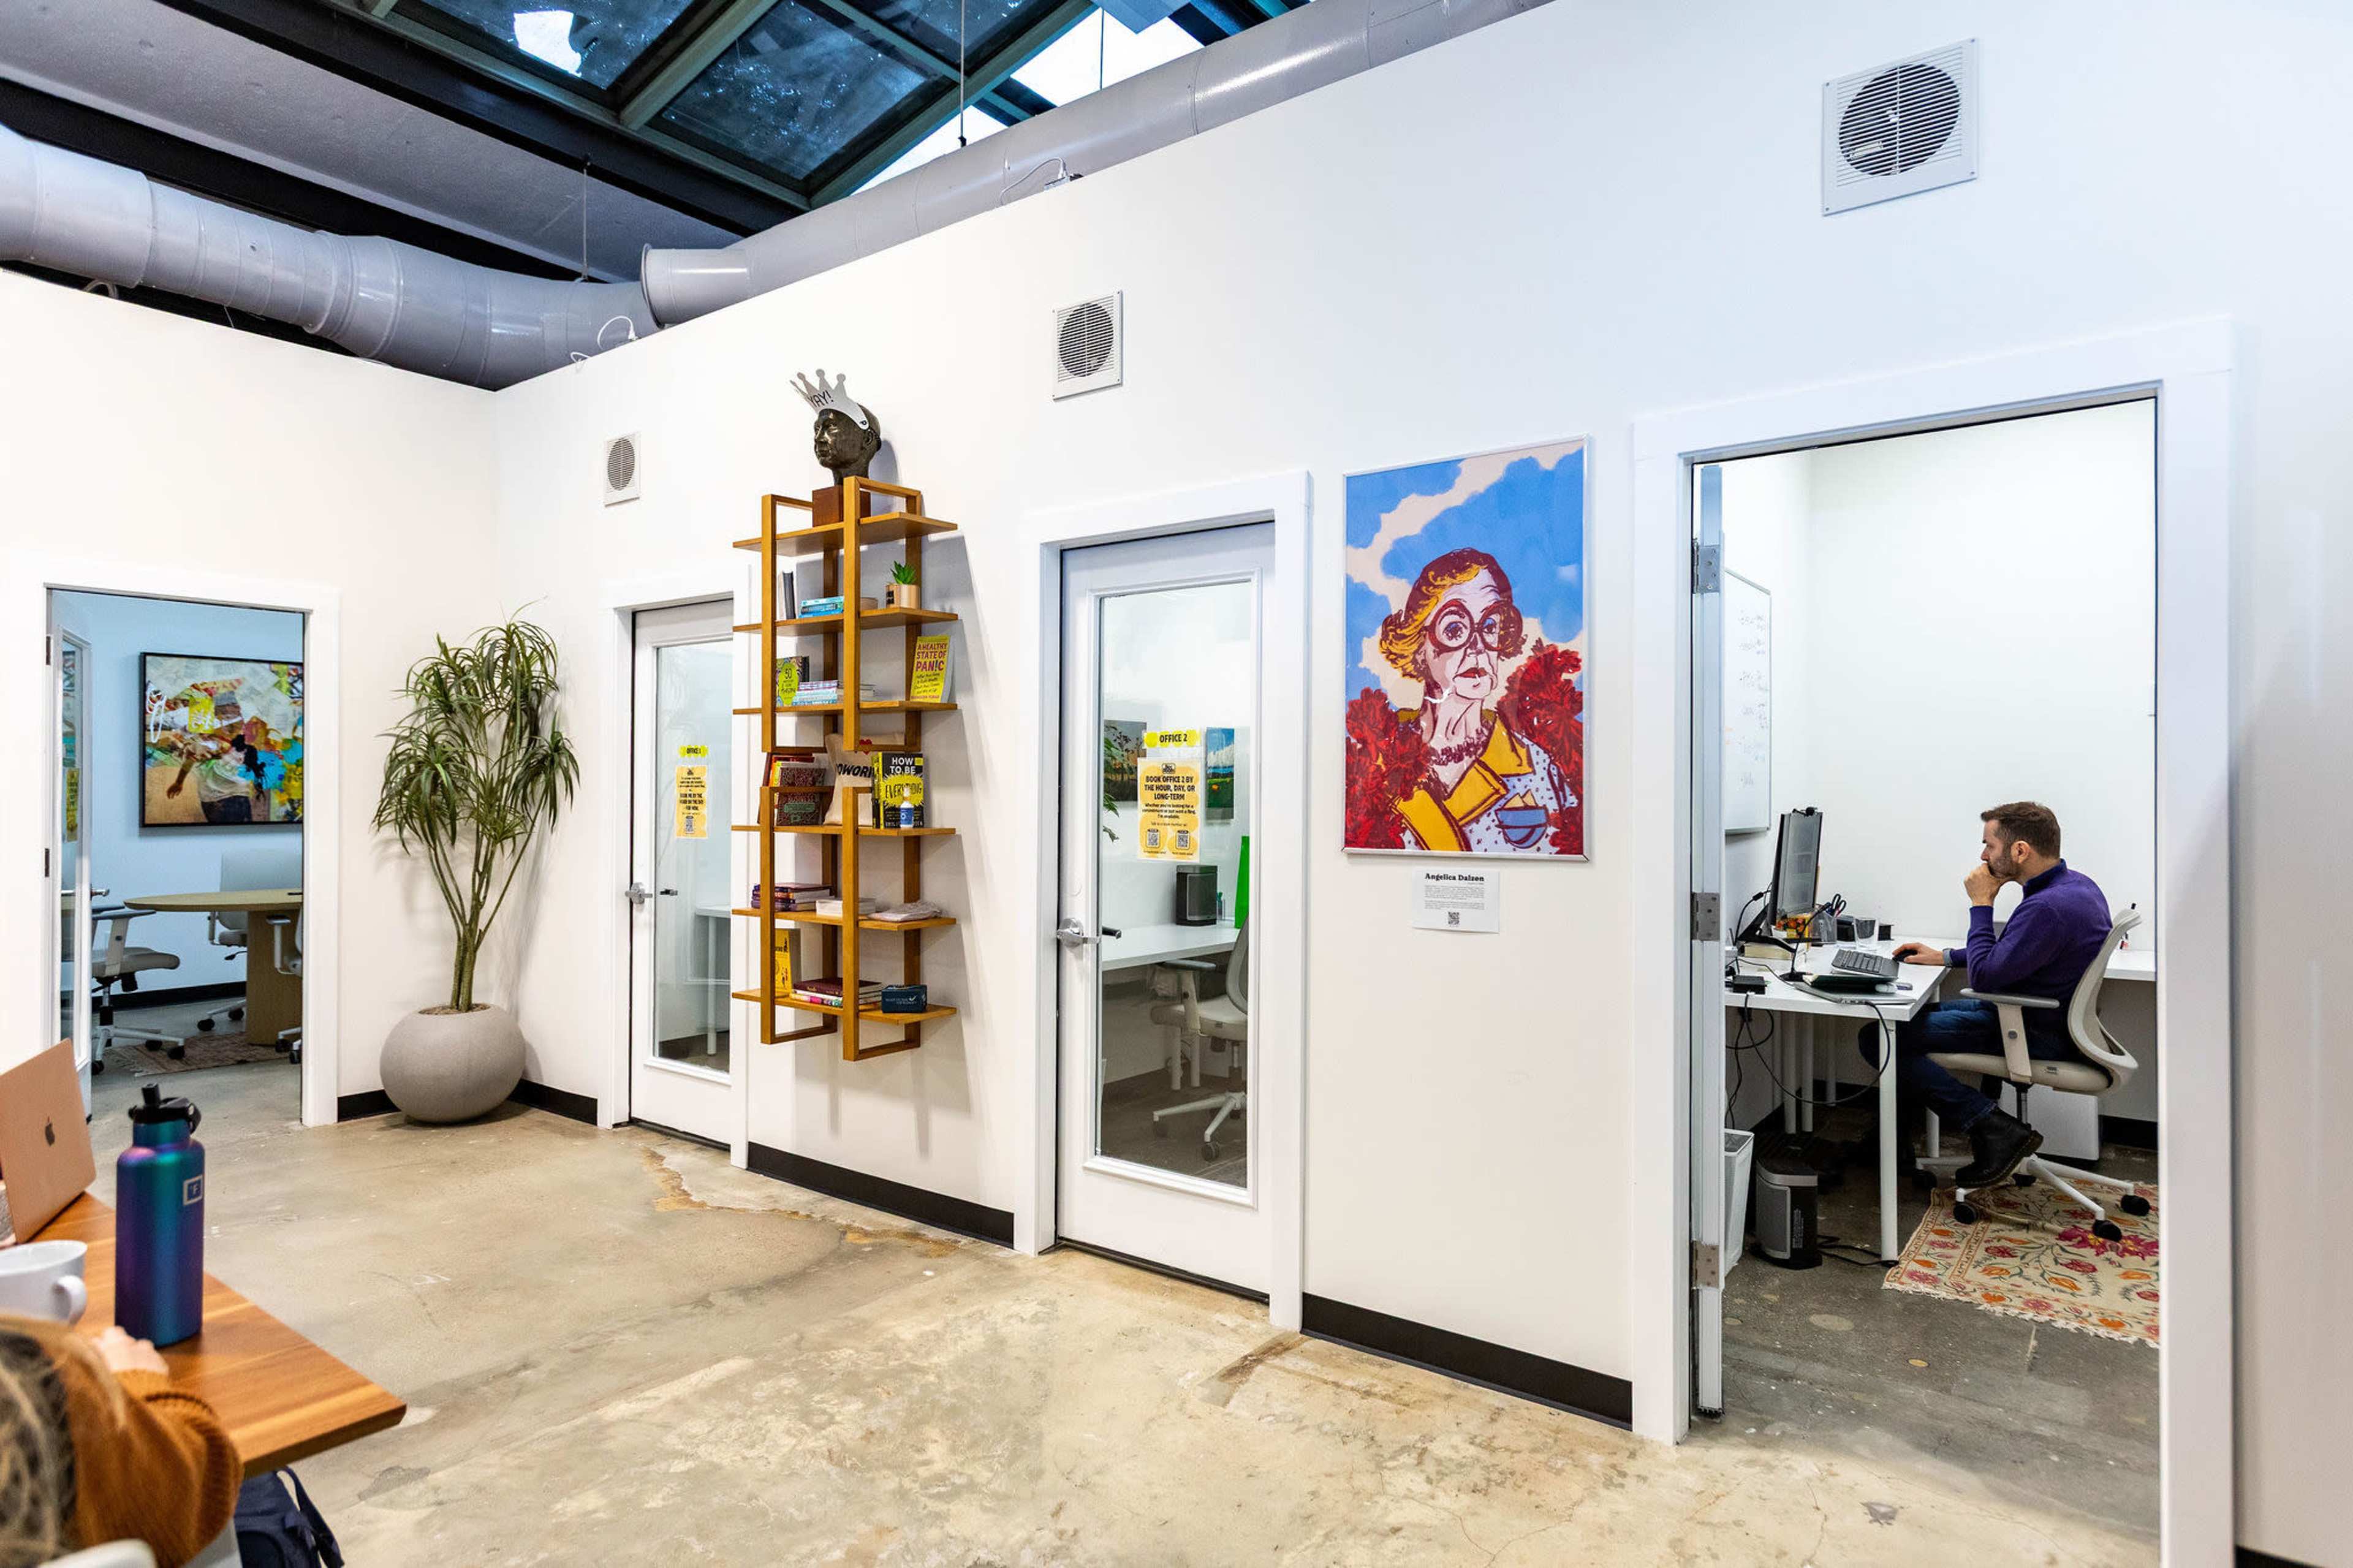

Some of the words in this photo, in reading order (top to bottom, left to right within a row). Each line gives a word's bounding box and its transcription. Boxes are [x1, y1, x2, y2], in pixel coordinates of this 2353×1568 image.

[808, 390, 833, 407] YAY!
[1160, 734, 1181, 743] OFFICE
[1425, 873, 1456, 881] Angelica
